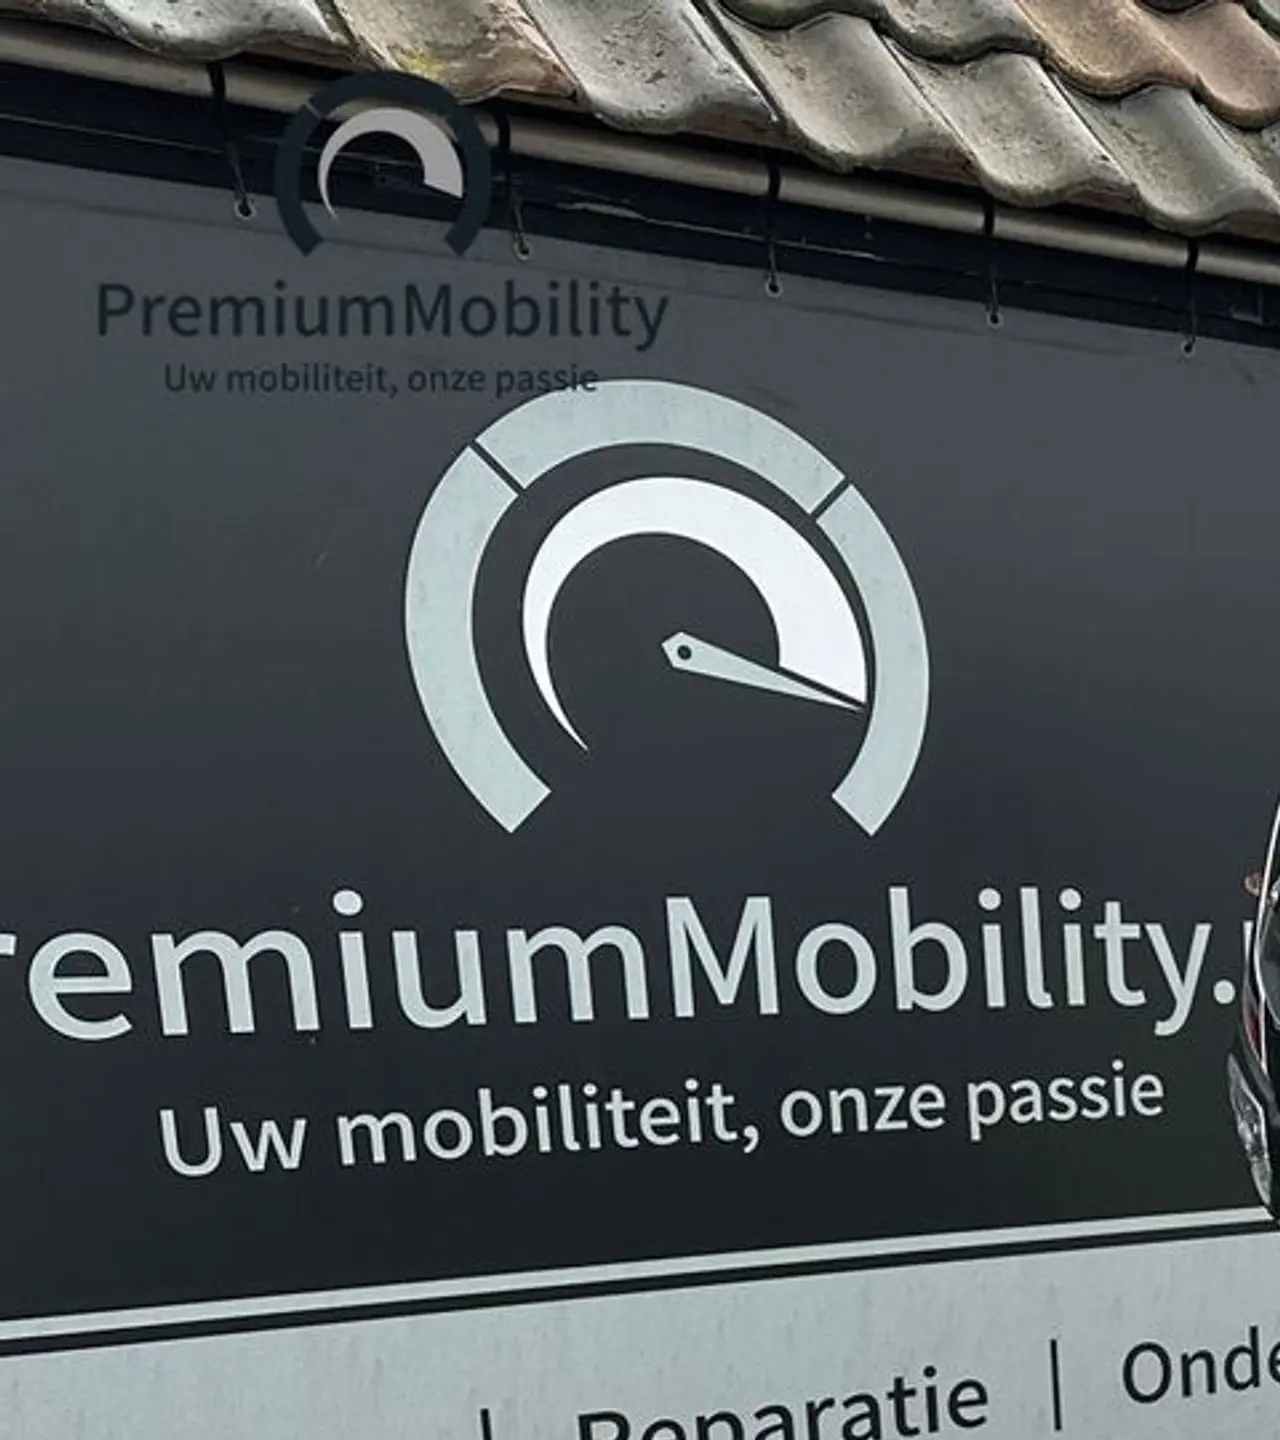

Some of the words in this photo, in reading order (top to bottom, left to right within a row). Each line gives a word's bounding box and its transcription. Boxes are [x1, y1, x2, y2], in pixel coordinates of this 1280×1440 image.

[160, 1107, 308, 1177] Uw
[337, 1079, 761, 1166] mobiliteit,
[780, 1081, 946, 1138] onze
[967, 1061, 1164, 1141] passie
